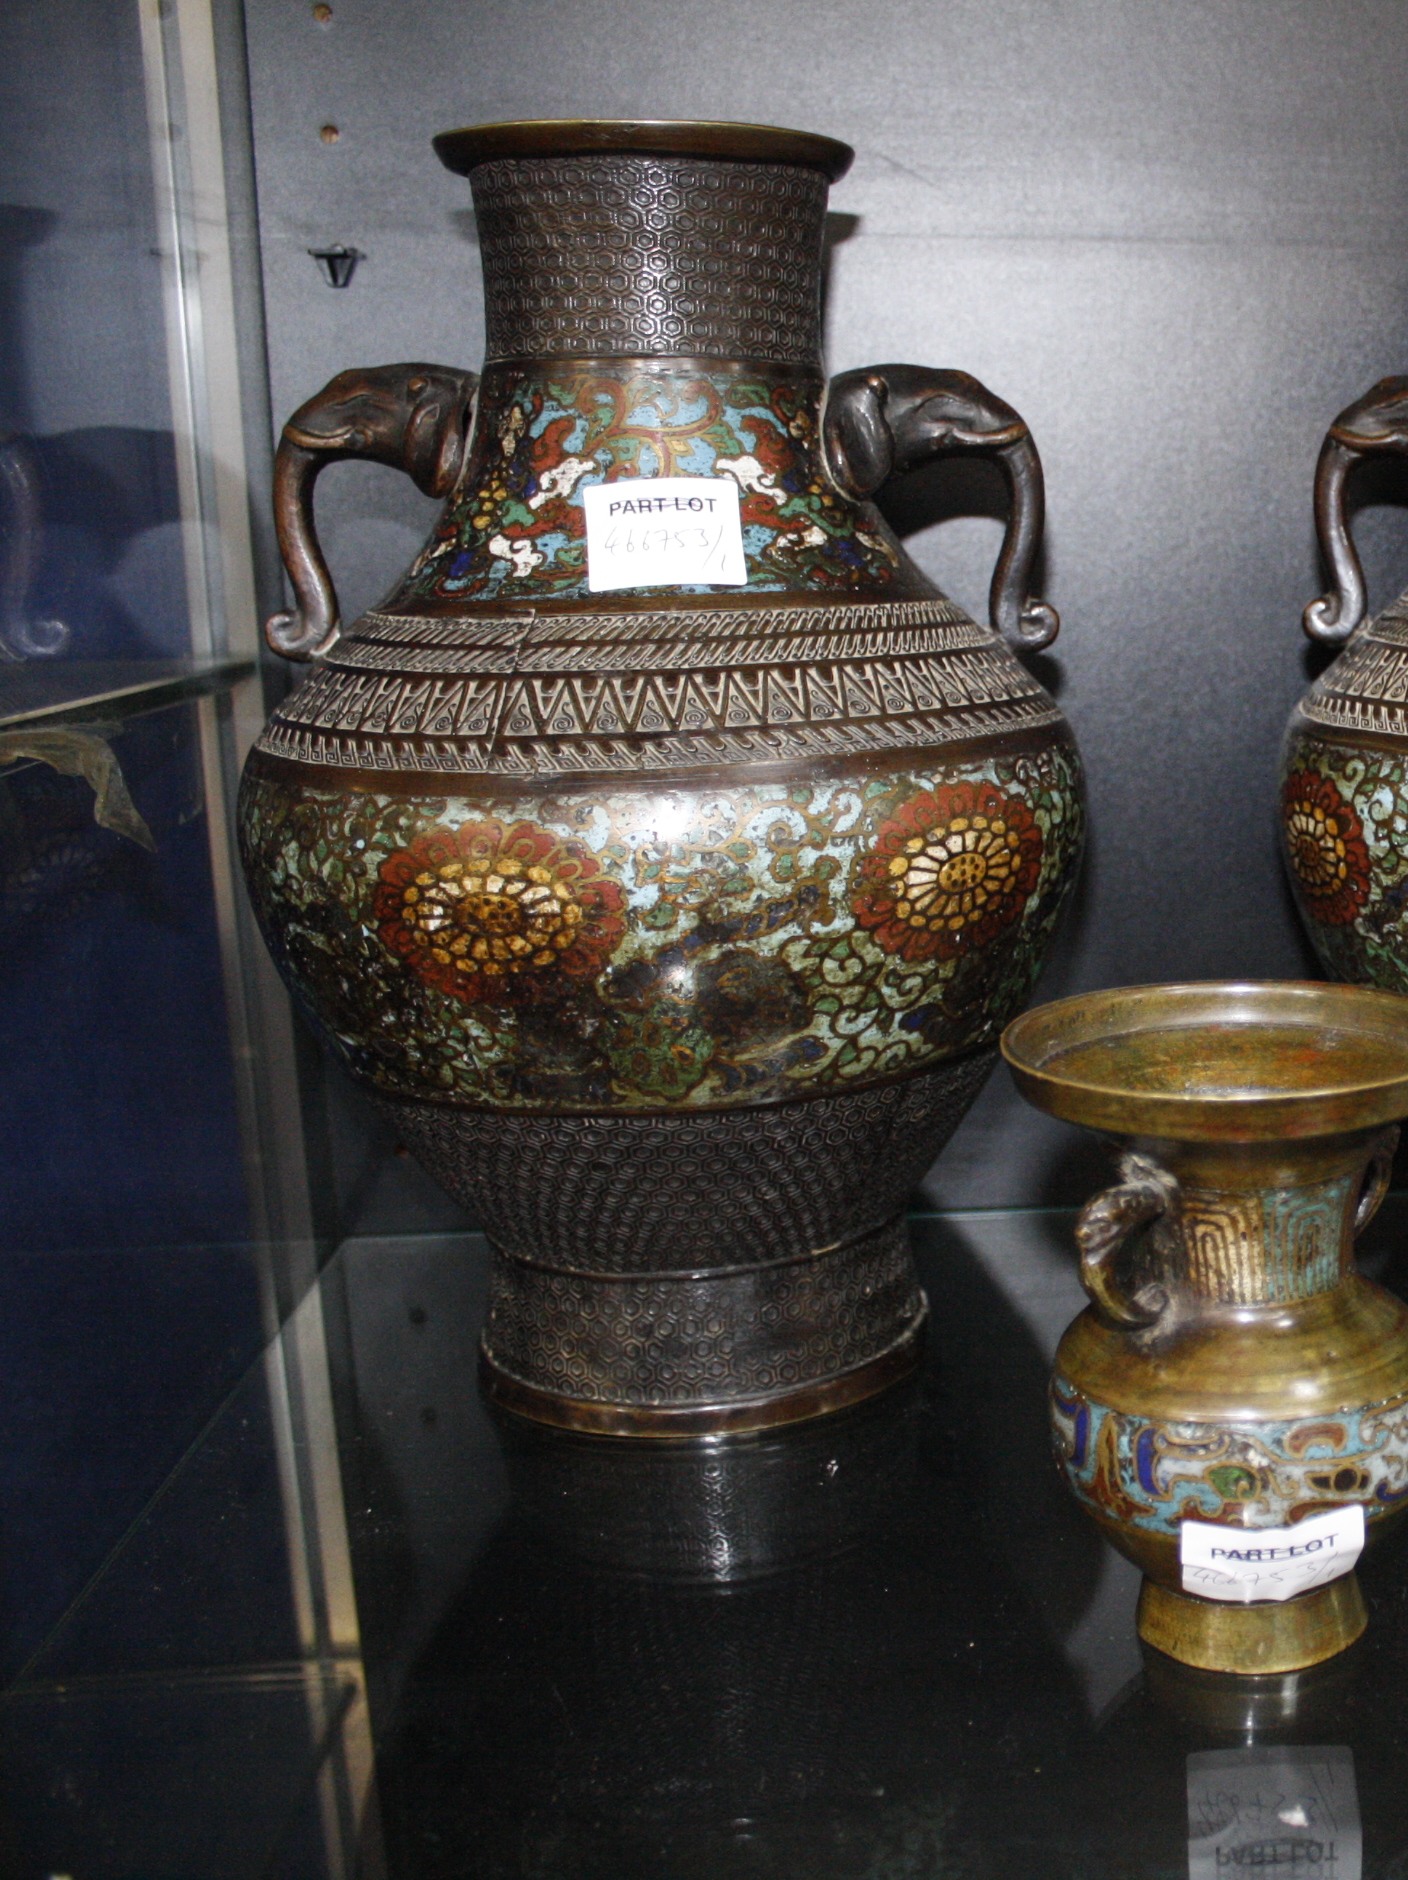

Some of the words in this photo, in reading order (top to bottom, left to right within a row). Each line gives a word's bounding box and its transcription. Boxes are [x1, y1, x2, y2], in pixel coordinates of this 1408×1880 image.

[609, 497, 668, 517] PART
[674, 497, 718, 513] LOT
[1210, 1547, 1280, 1562] PART
[1289, 1533, 1340, 1556] LOT
